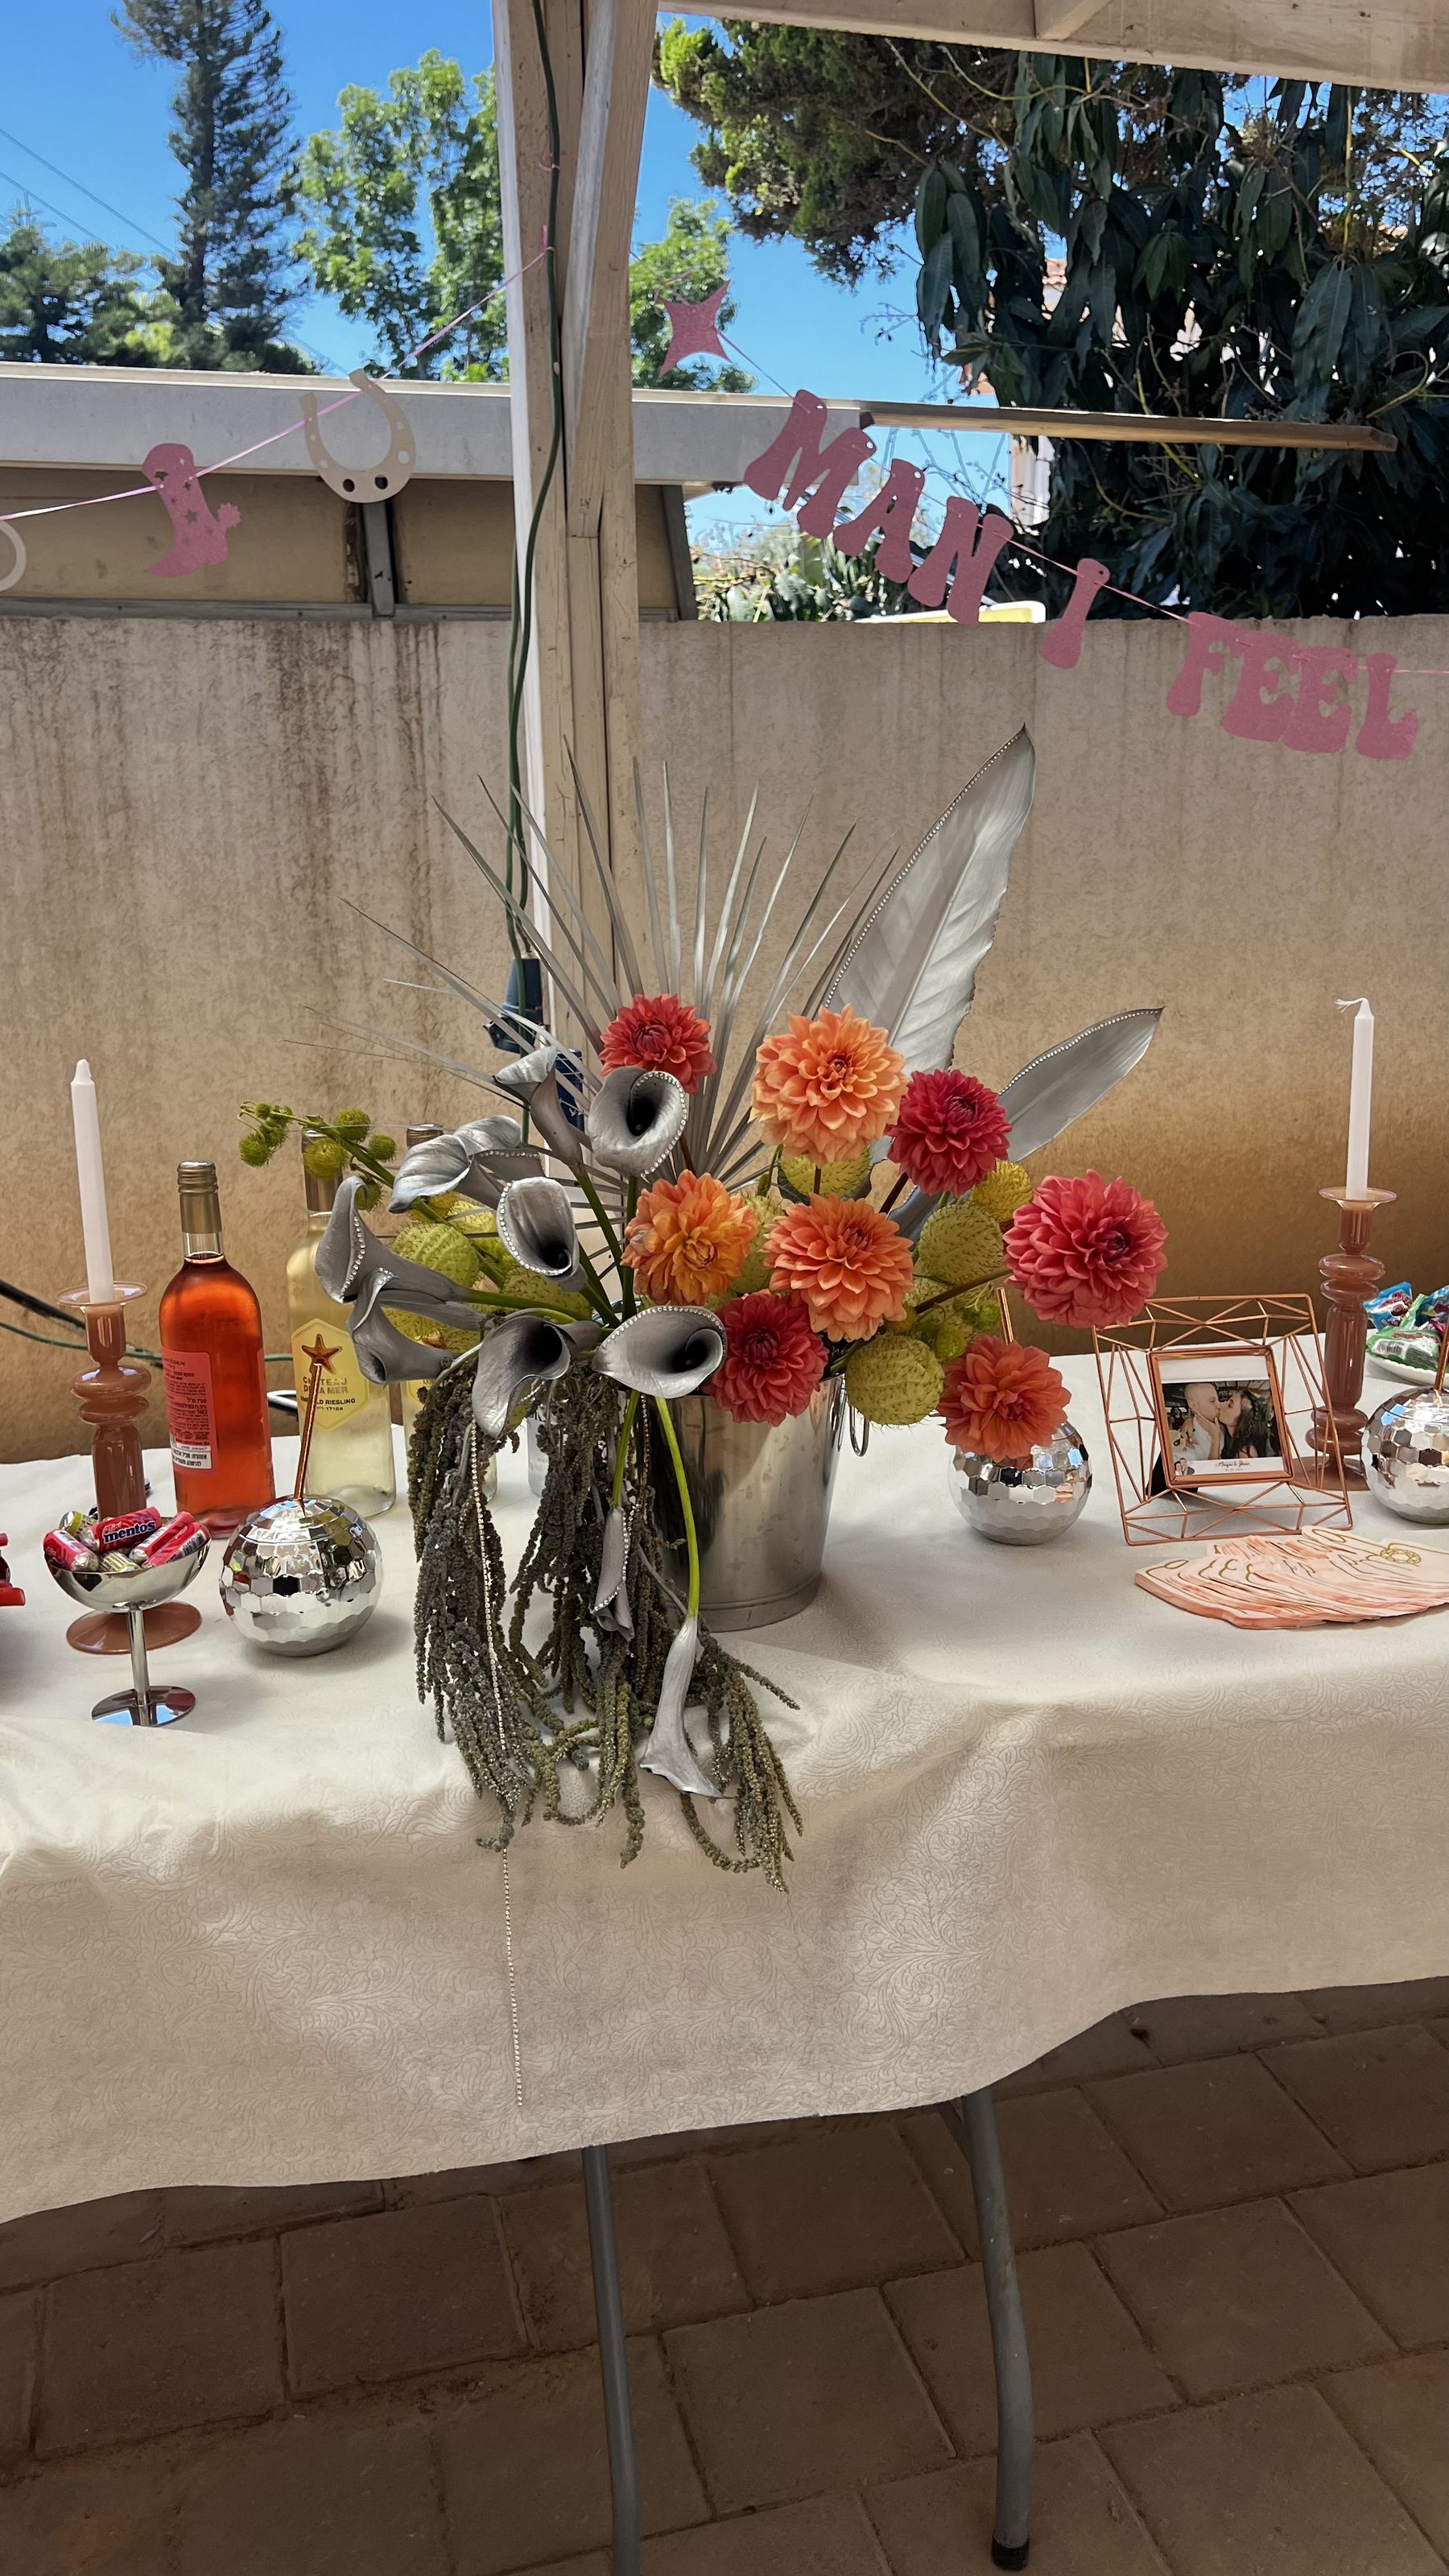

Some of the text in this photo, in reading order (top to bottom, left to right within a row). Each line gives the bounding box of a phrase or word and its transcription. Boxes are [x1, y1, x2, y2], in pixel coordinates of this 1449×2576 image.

[744, 389, 1418, 760] MAN I FEEL
[103, 1521, 156, 1544] mentos
